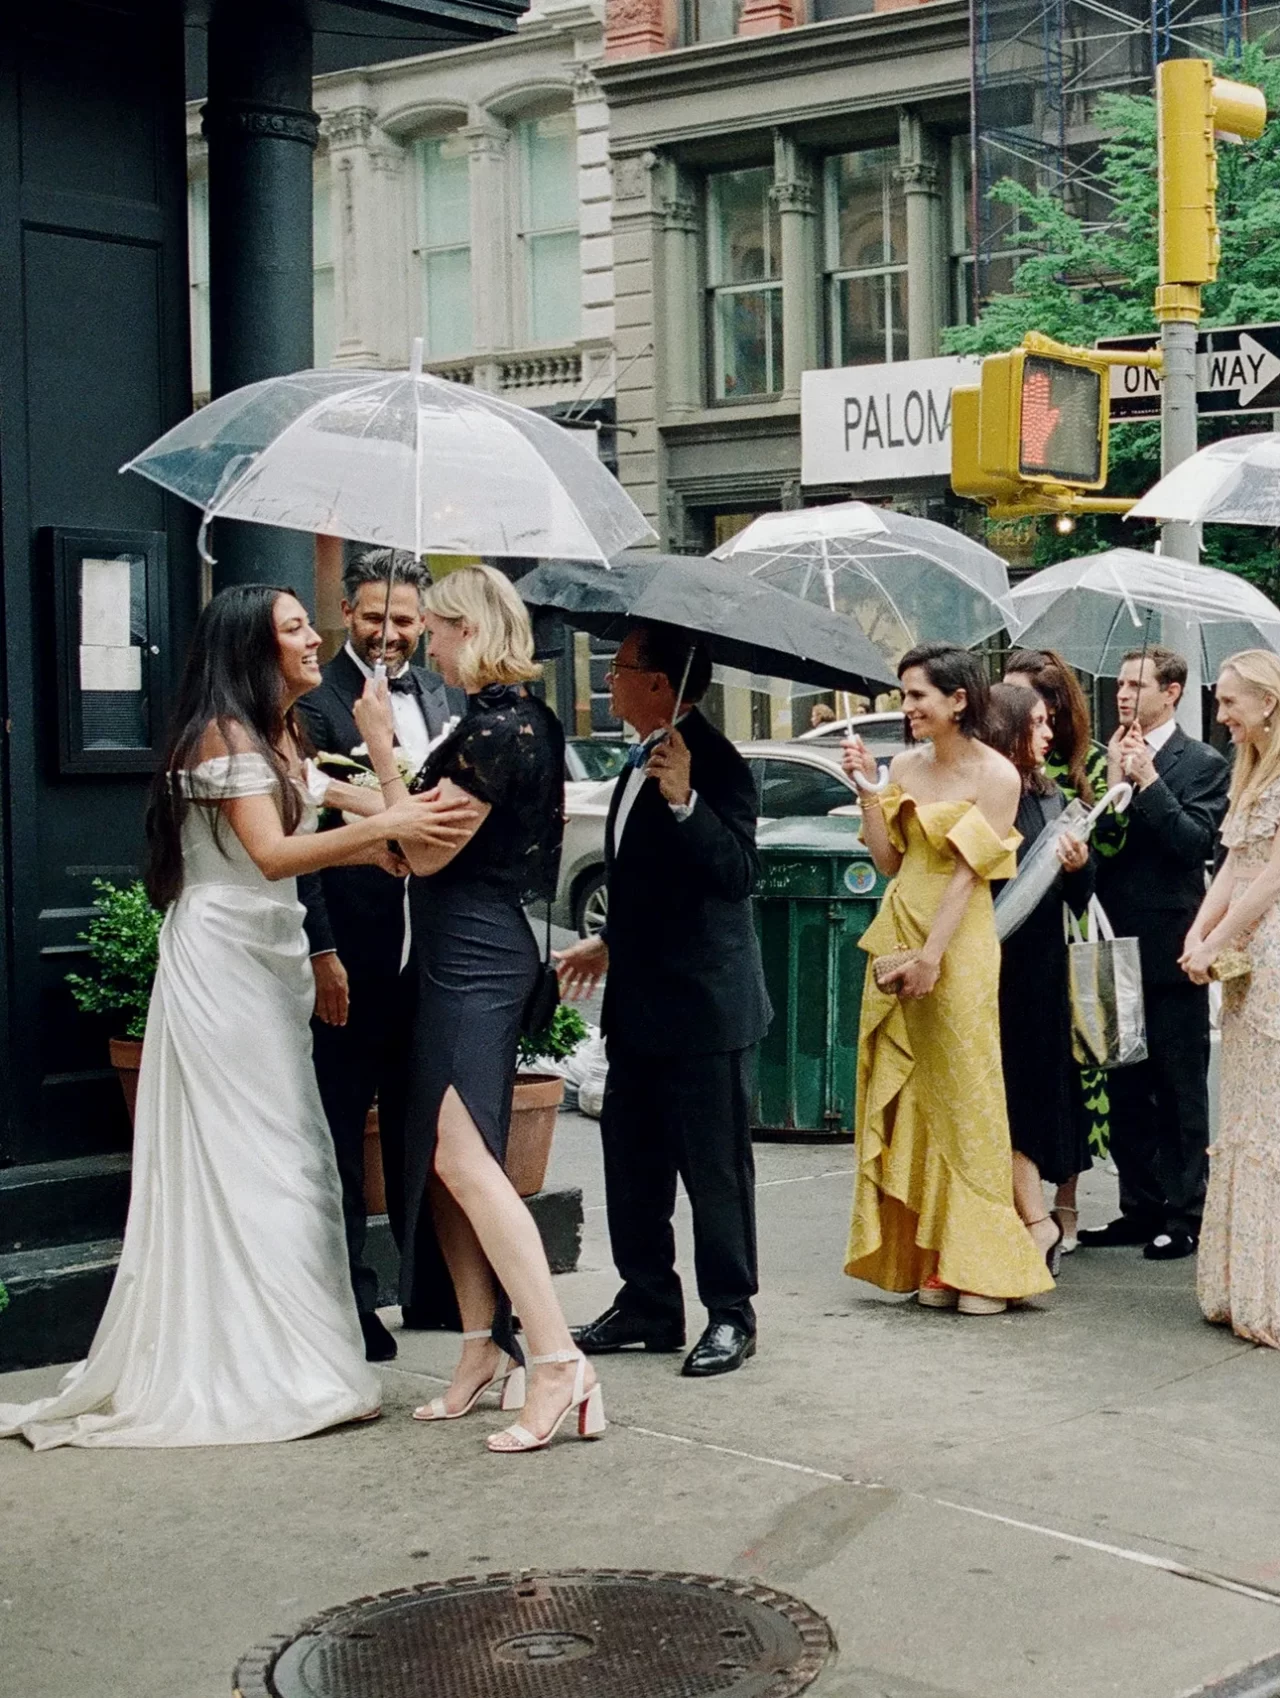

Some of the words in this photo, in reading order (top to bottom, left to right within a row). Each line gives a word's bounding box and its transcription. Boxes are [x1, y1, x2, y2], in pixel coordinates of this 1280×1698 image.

[1123, 364, 1161, 394] ON
[1210, 353, 1267, 388] WAY
[844, 387, 952, 453] PALOM
